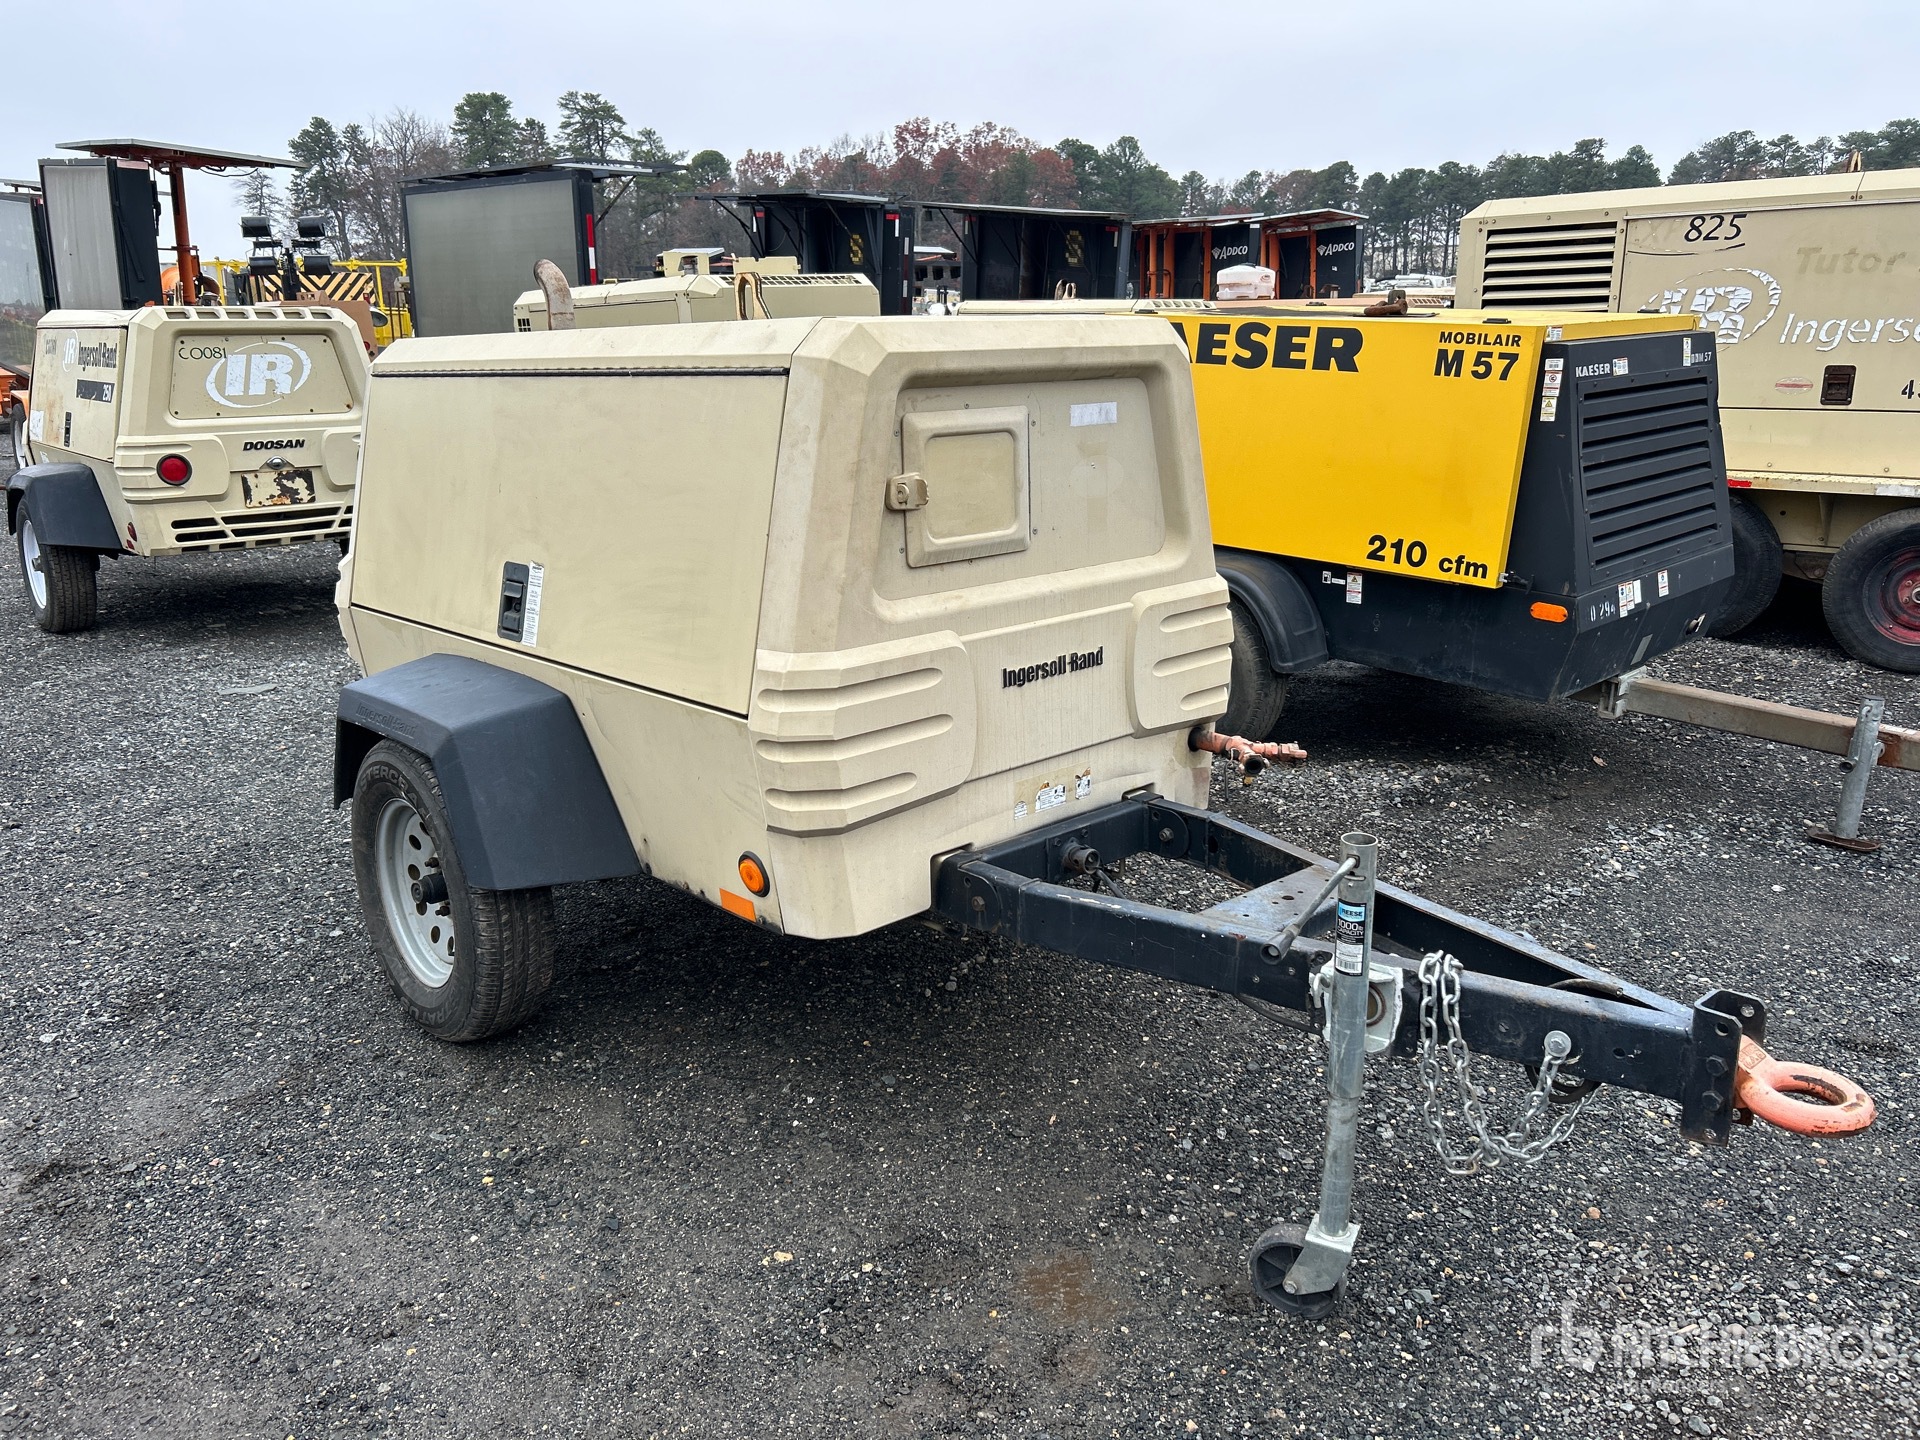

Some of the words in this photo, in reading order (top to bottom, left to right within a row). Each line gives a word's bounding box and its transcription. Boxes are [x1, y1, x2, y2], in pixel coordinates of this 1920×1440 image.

[1684, 213, 1747, 242] 825
[1219, 245, 1249, 260] ADDCO
[1325, 242, 1355, 256] ADDCO
[1797, 247, 1907, 275] Tutor
[1439, 331, 1522, 348] MOBILAIR
[225, 353, 294, 396] IR
[1575, 363, 1611, 378] KAESER
[1901, 379, 1920, 400] 4
[243, 438, 306, 452] DOOSAN
[1366, 534, 1428, 568] 210
[1438, 555, 1488, 579] cfm
[1002, 646, 1104, 689] Ingersoll-Rand
